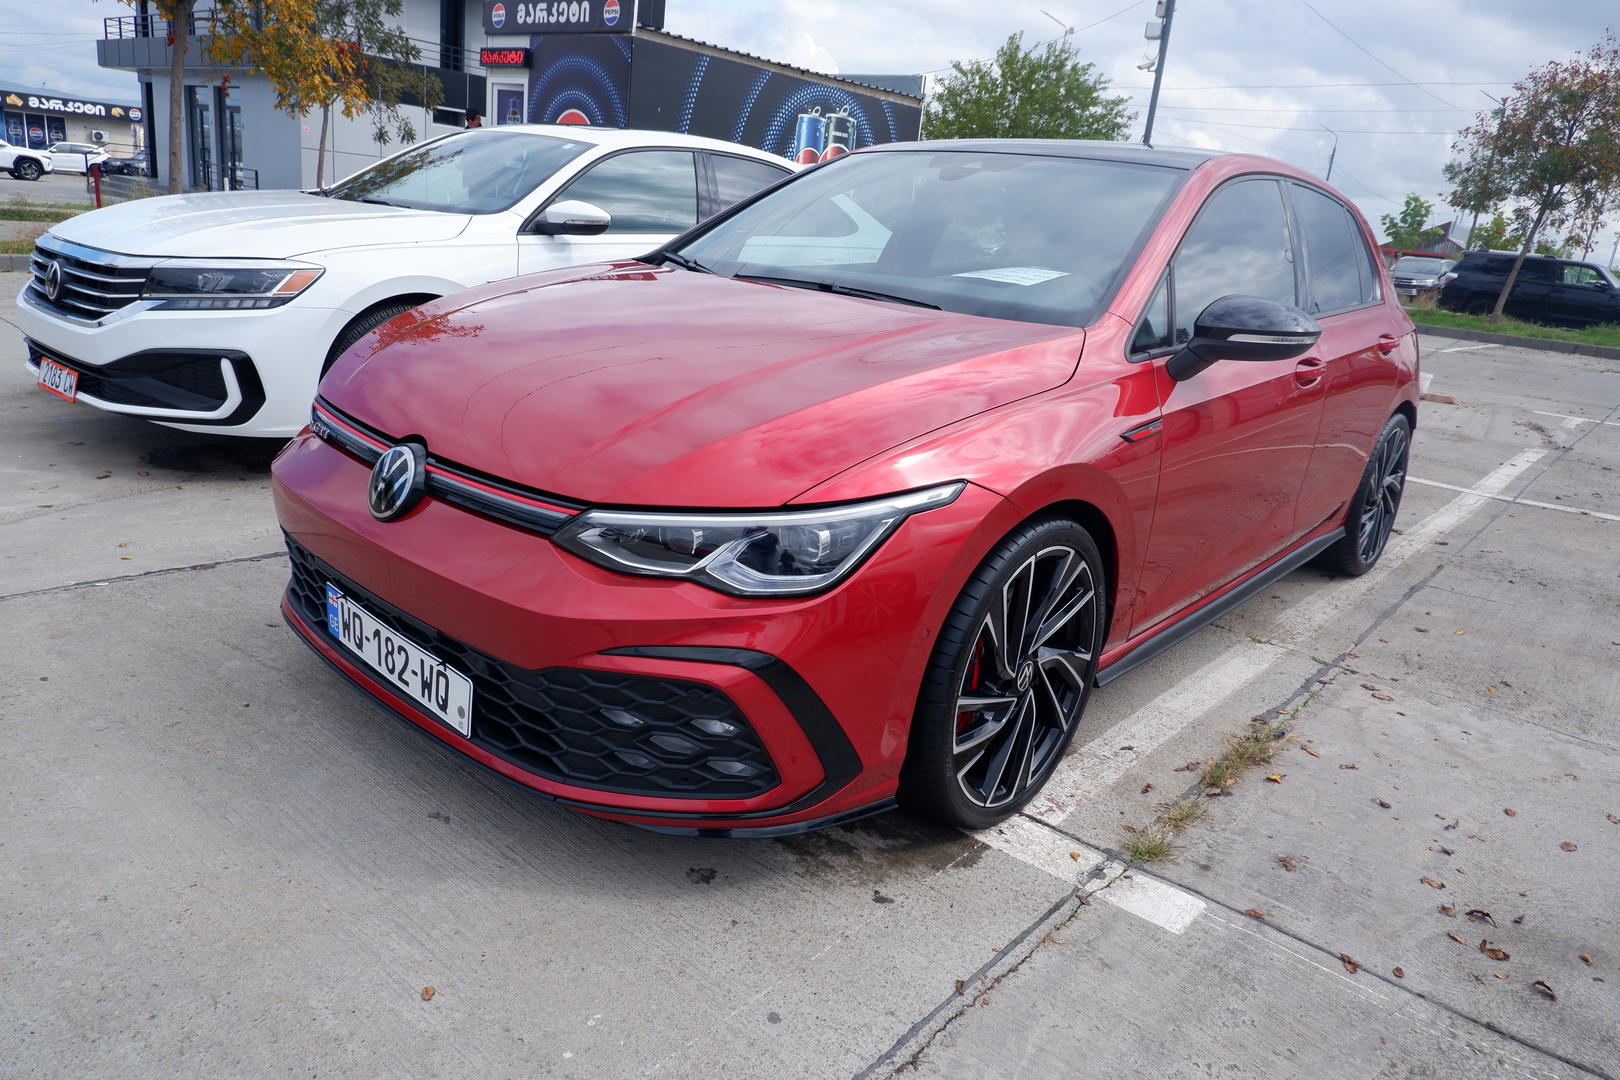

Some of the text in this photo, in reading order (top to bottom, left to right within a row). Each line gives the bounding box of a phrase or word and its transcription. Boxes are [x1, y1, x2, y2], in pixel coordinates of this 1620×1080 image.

[516, 1, 590, 24] მარკეტი
[28, 96, 106, 117] მარკეტი
[329, 613, 339, 633] GE
[340, 601, 450, 715] WQ-182-WQ
